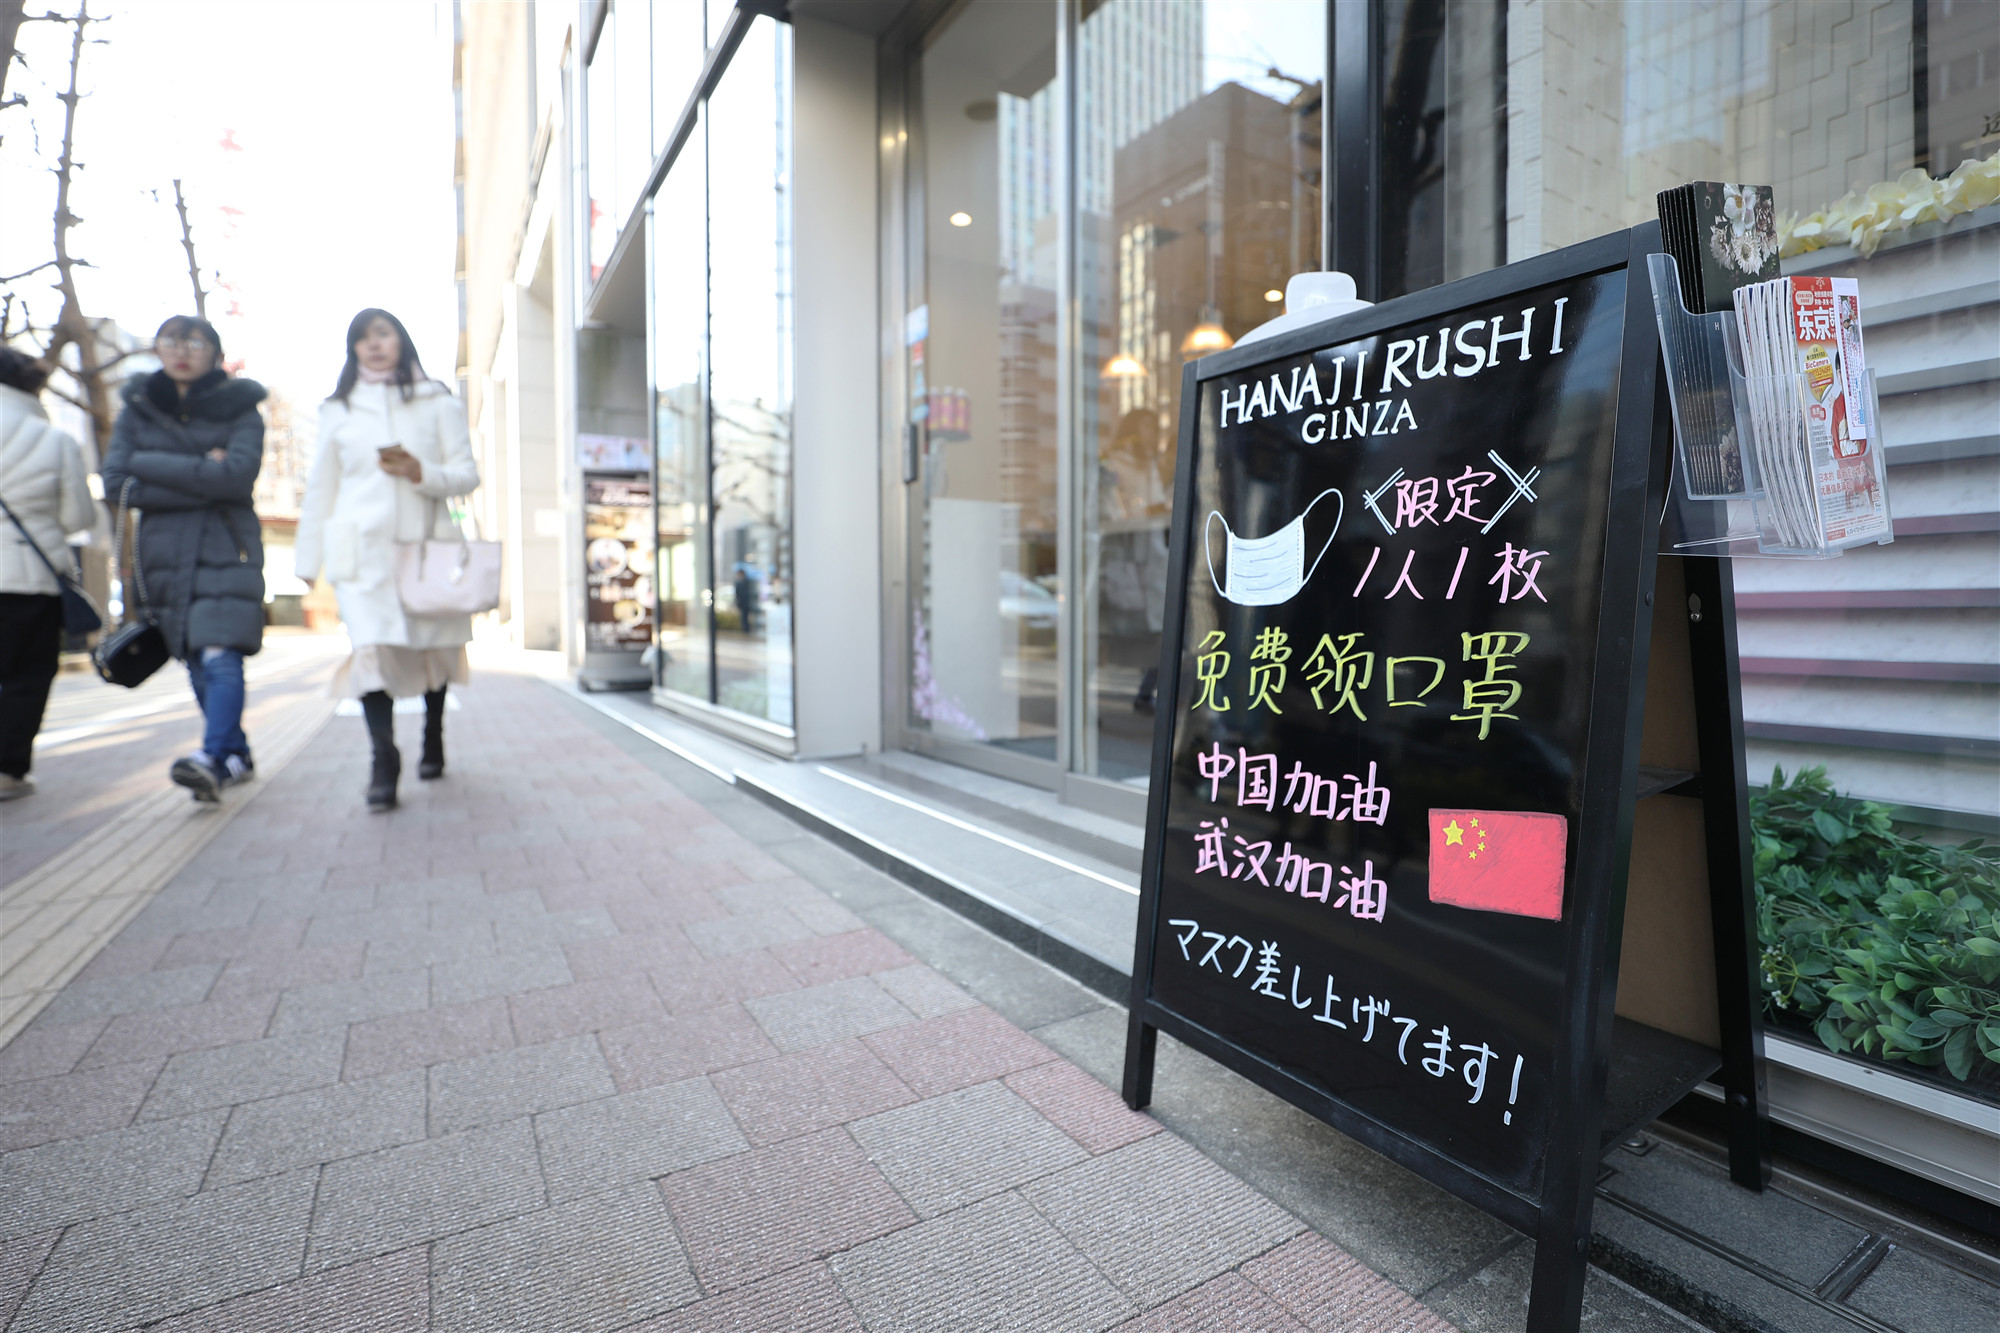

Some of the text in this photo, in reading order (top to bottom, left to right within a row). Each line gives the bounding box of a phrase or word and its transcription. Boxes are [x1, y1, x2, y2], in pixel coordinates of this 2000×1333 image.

[1301, 399, 1419, 445] GINZA
[1191, 626, 1531, 741] 免费领口罩
[1197, 741, 1391, 826] 中国加油
[1193, 817, 1388, 924] 武汉加油
